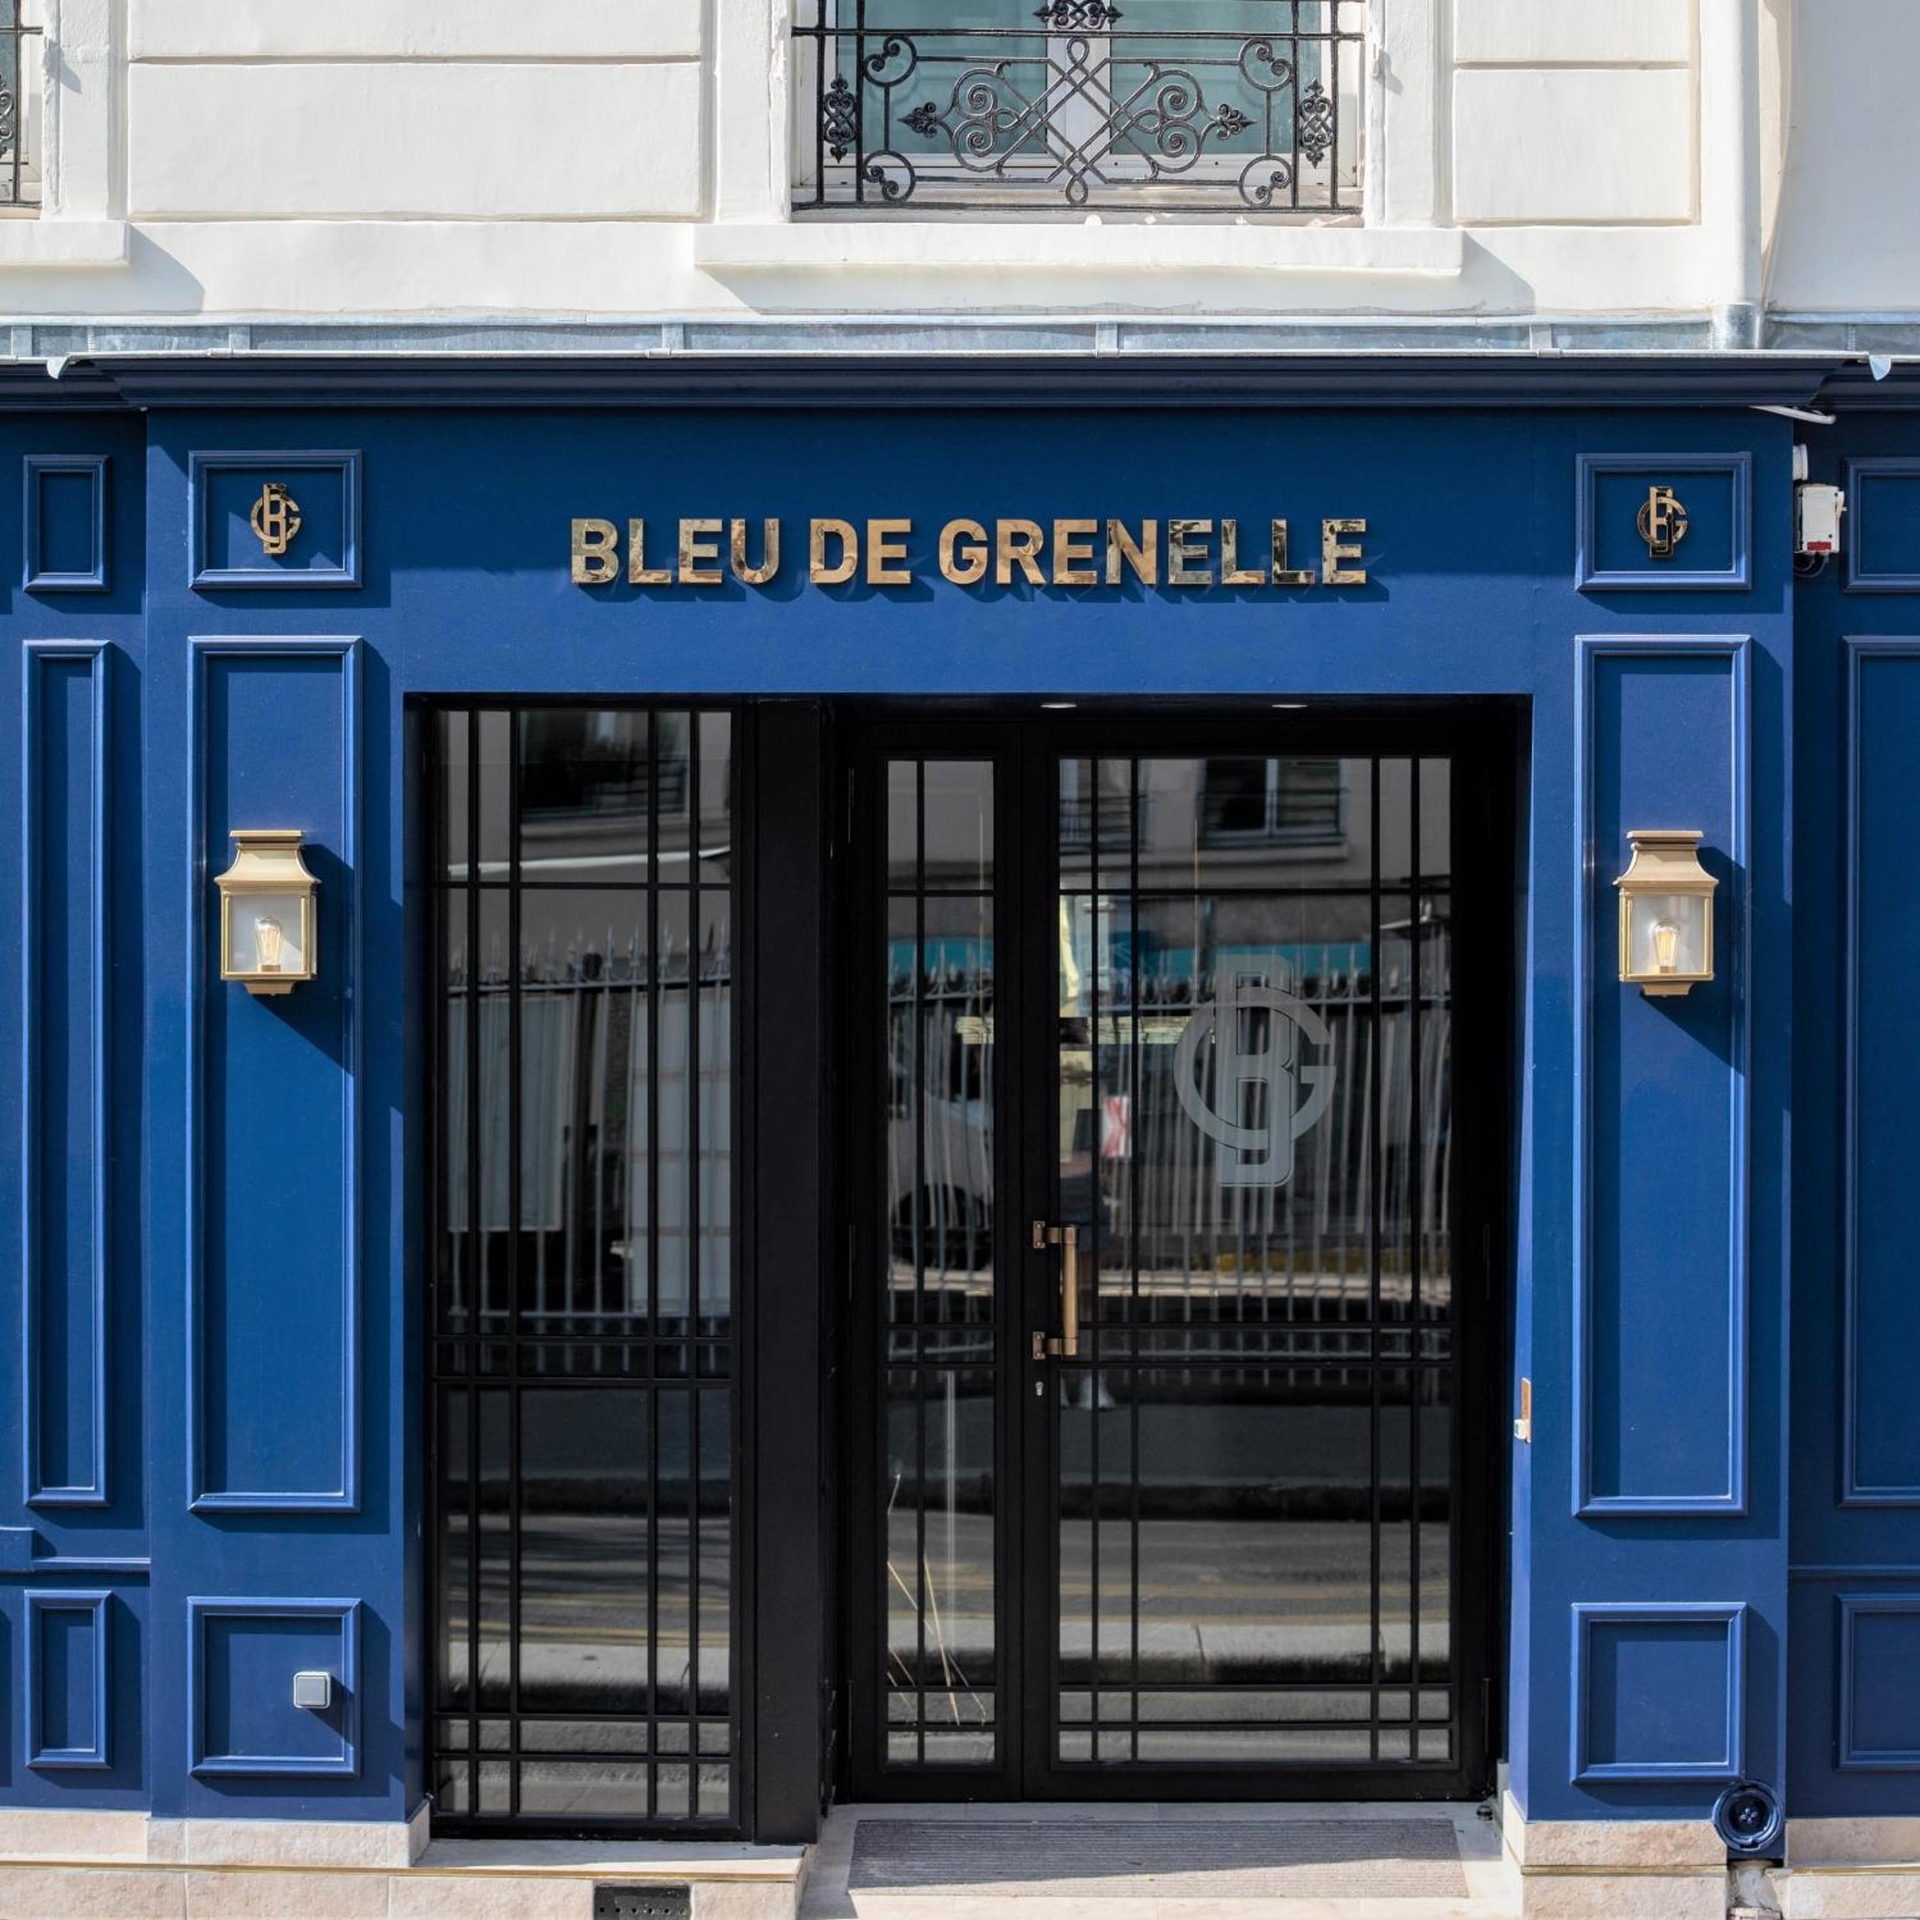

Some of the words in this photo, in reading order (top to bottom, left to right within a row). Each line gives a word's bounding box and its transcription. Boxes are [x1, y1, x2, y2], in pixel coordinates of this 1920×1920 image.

[571, 517, 780, 584] BLEU
[809, 518, 912, 584] DE
[938, 518, 1367, 585] GRENELLE
